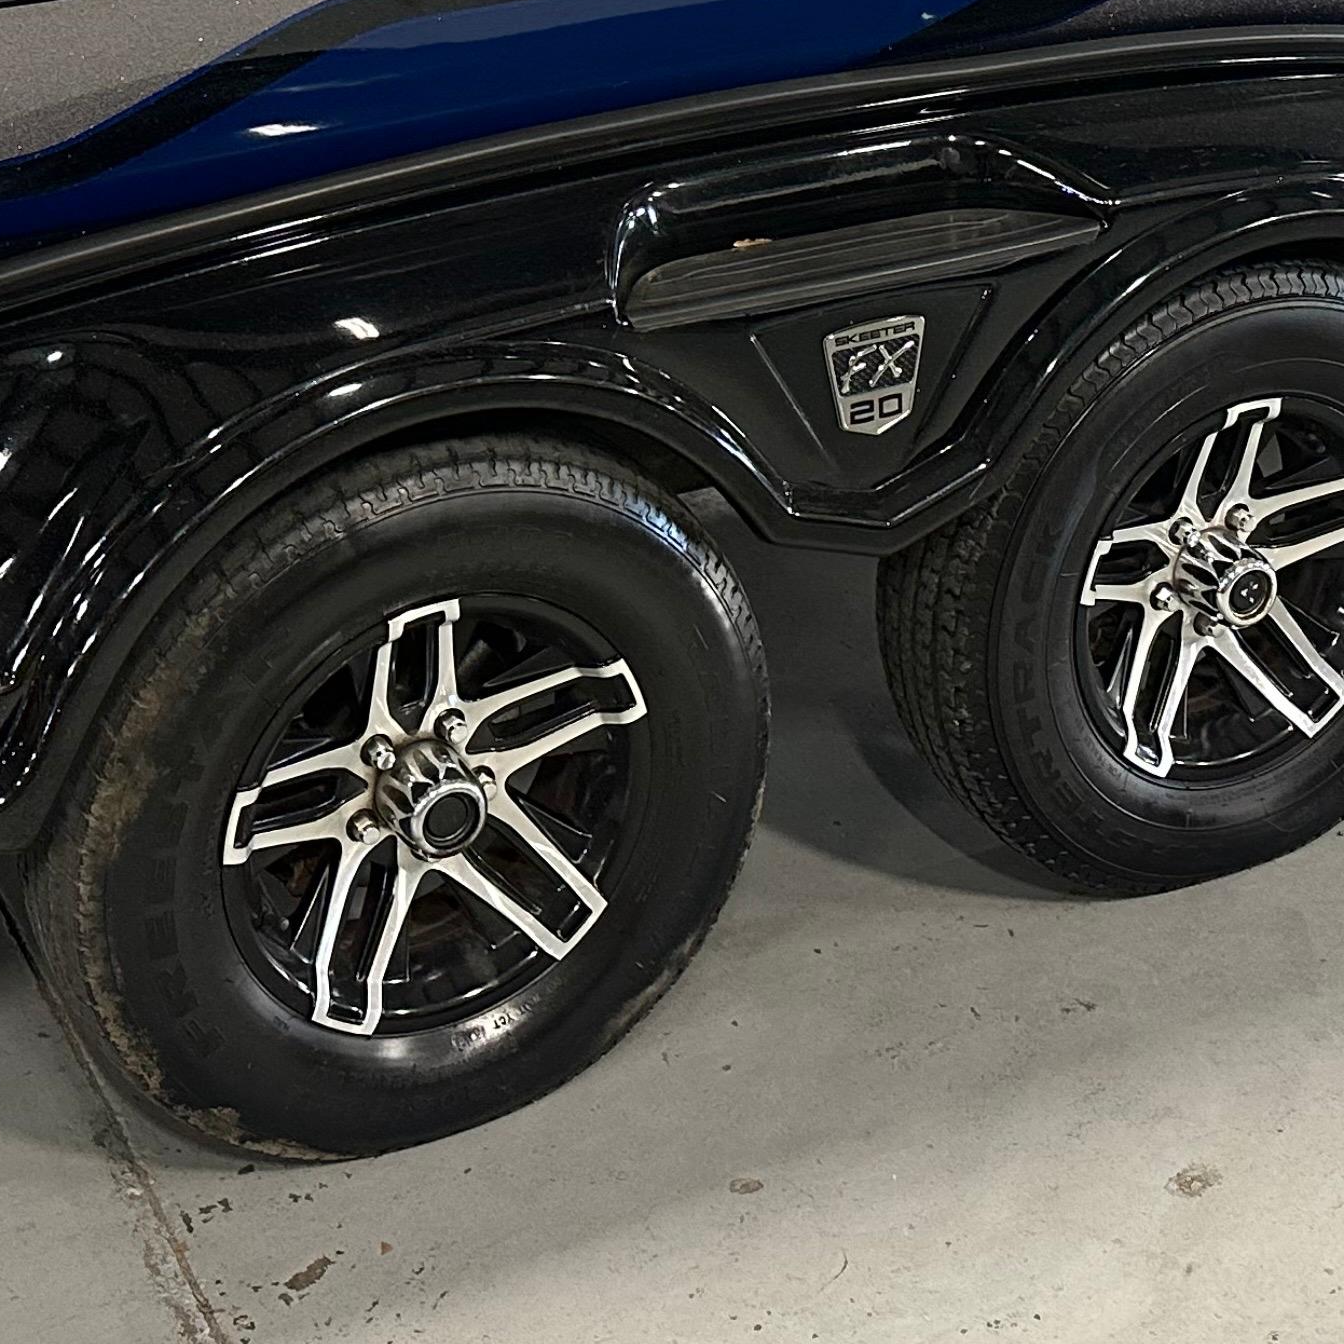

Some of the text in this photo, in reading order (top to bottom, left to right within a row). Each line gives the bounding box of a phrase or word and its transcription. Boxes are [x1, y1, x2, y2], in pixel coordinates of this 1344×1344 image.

[835, 320, 916, 347] SKEETER
[840, 341, 915, 394] FX
[850, 393, 904, 425] 20
